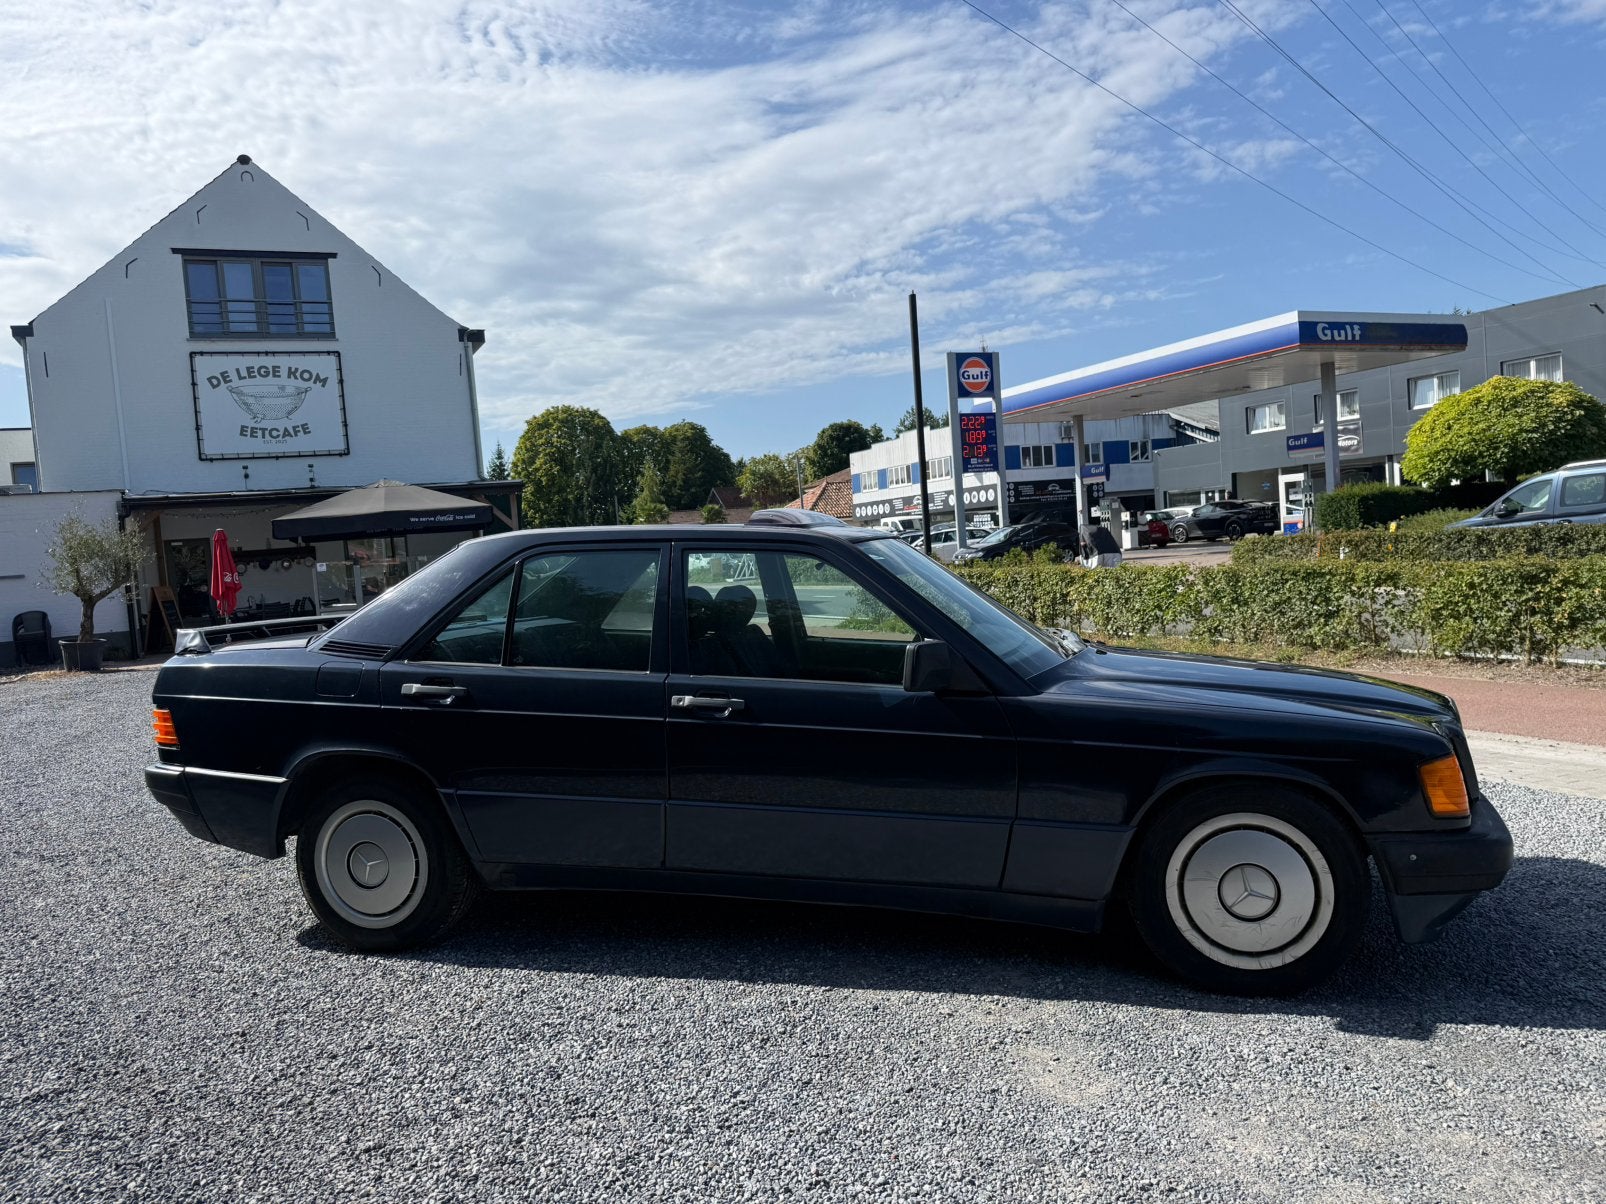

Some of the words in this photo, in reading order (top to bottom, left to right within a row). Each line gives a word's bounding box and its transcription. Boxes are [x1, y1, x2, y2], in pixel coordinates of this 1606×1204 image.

[1316, 323, 1361, 341] Gulf
[206, 370, 233, 390] DE
[235, 365, 281, 381] LEGE
[287, 366, 329, 388] KOM
[961, 370, 990, 381] Gulf
[239, 422, 312, 440] EETCAFE
[1288, 437, 1308, 446] Gulf
[1091, 466, 1104, 474] Gulf
